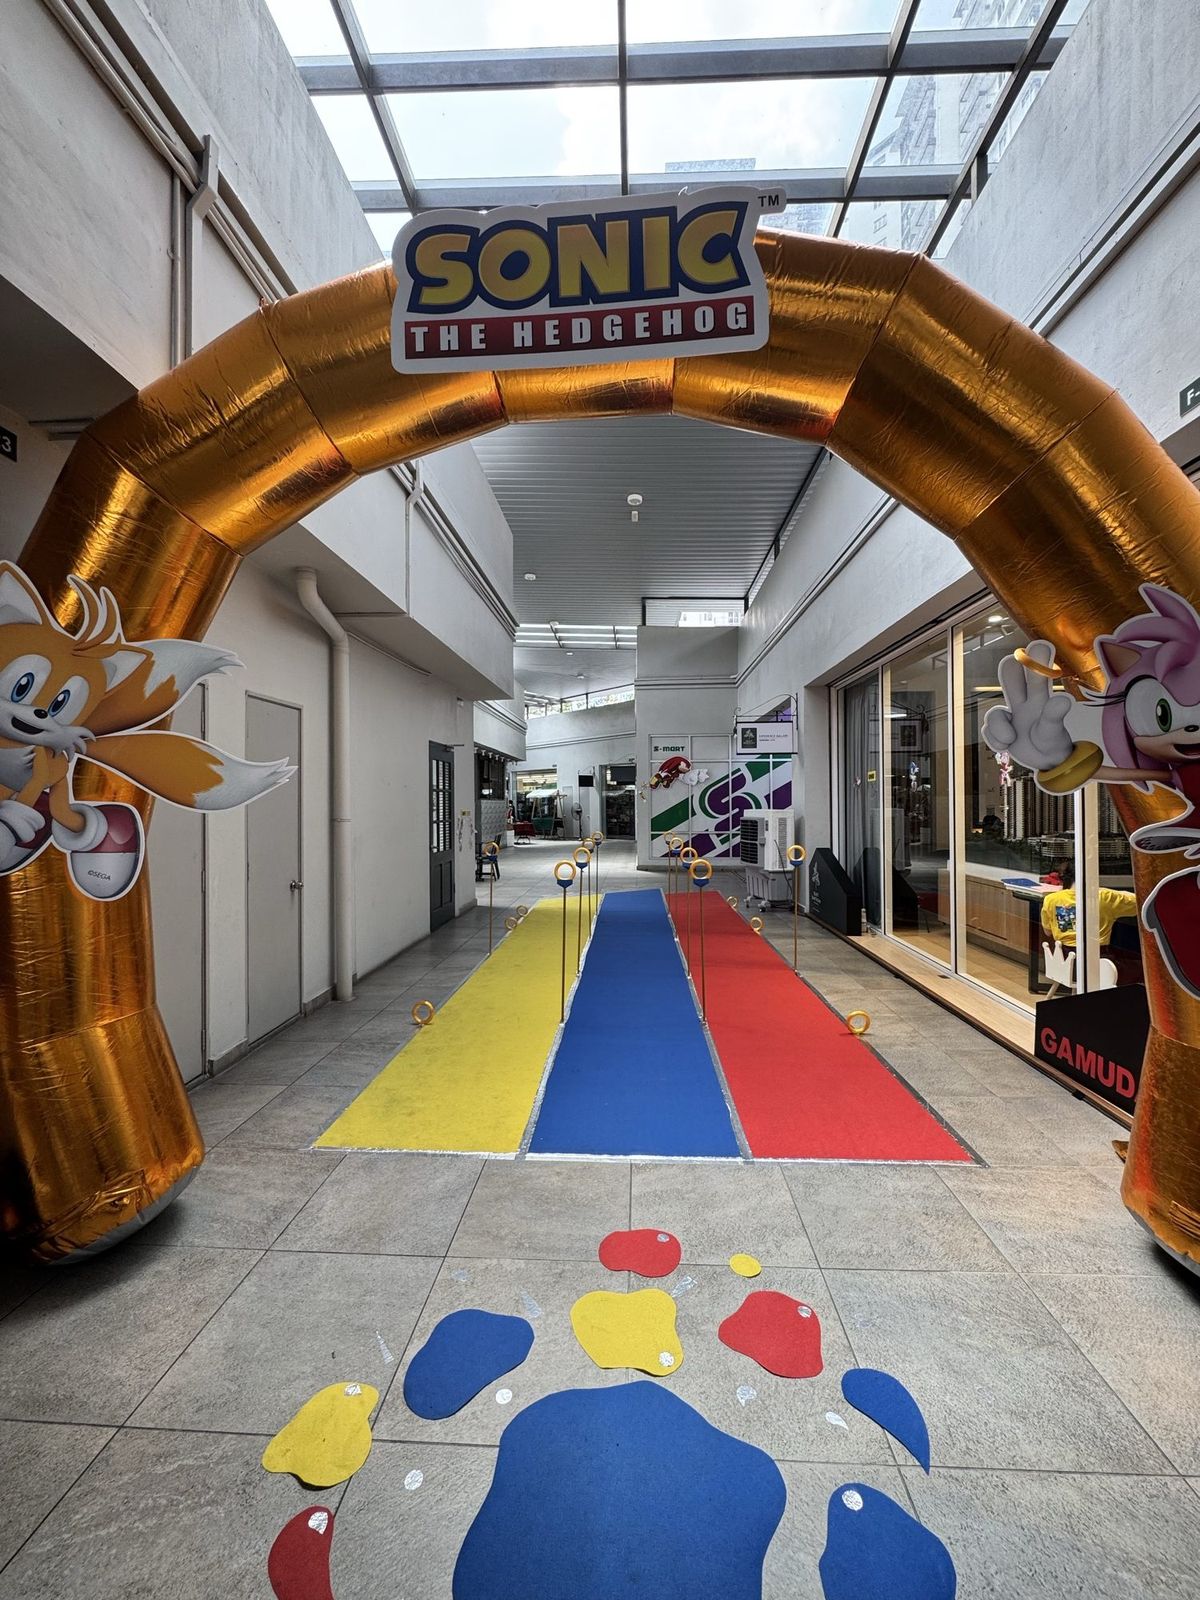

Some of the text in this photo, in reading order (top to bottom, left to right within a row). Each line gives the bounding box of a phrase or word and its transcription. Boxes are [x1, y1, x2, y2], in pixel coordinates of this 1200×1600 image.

[757, 194, 780, 208] TM
[407, 203, 750, 313] SONIC
[410, 302, 748, 353] THE HEDGEHOG
[1041, 1027, 1136, 1102] GAMUD
